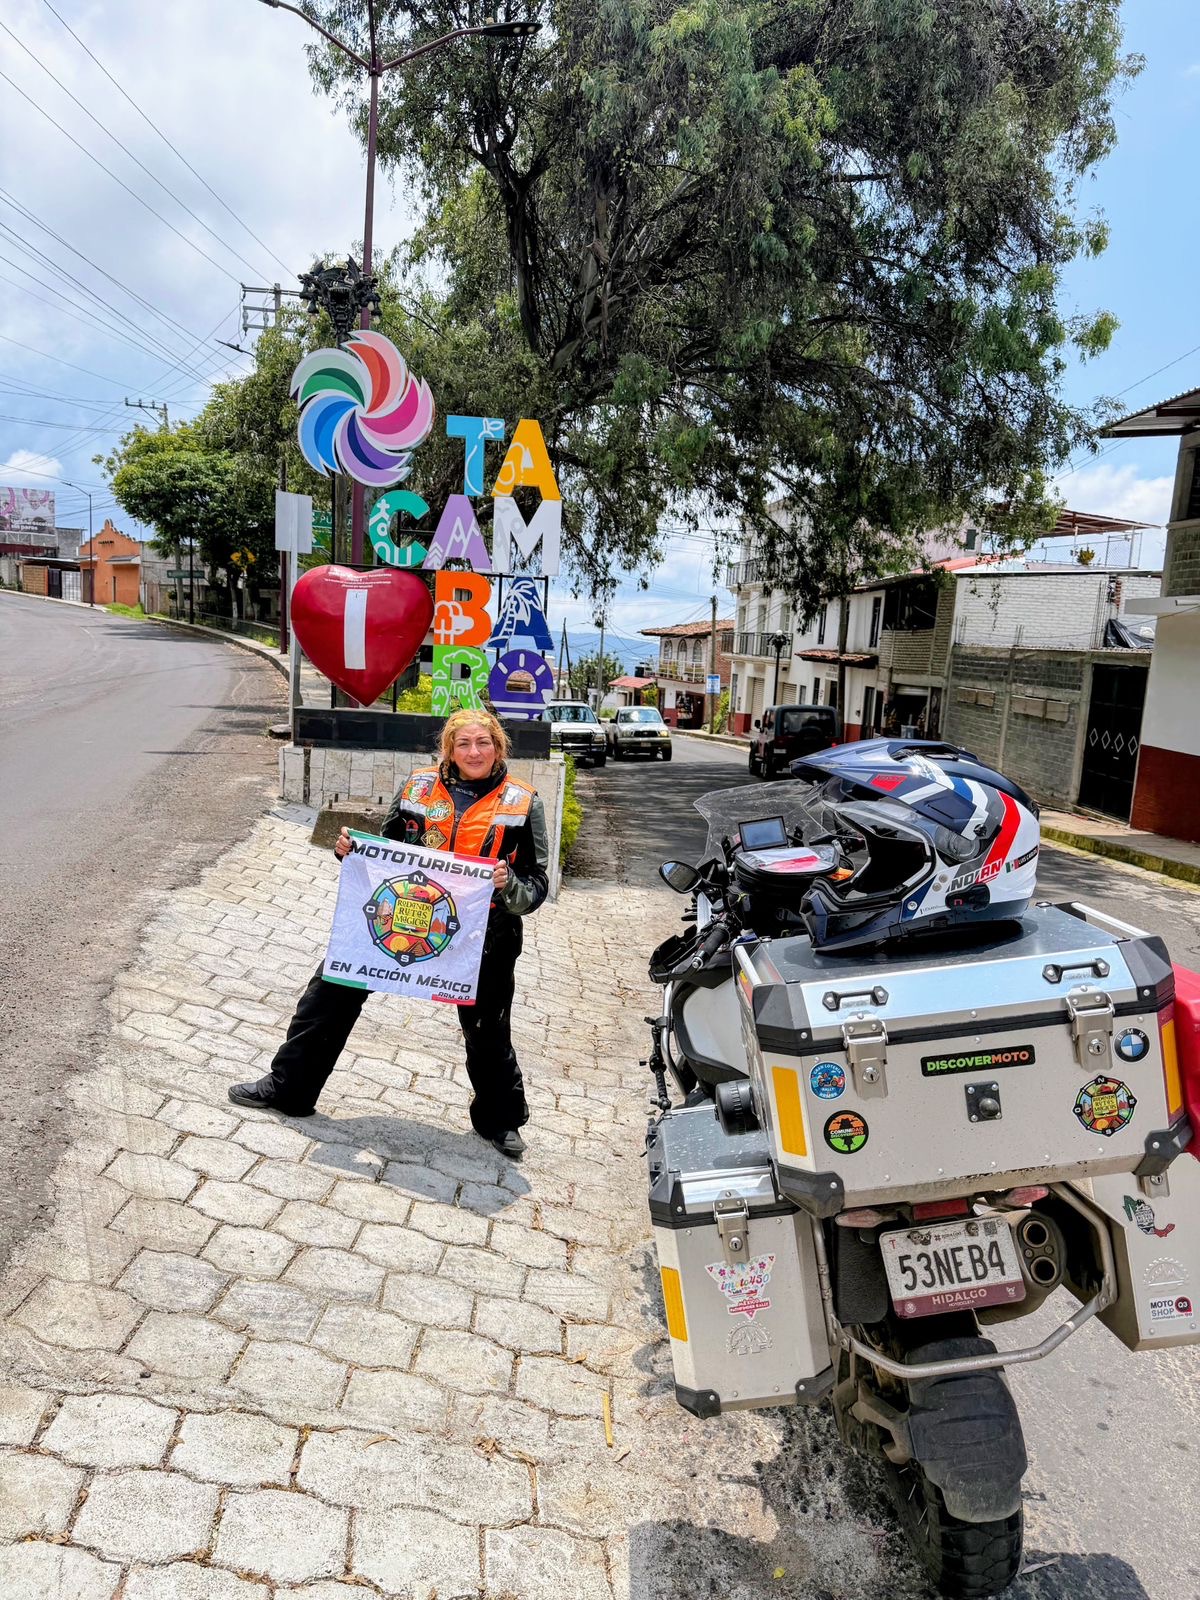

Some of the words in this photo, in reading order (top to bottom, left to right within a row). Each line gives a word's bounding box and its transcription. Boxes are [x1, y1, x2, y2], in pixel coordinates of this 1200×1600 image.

[446, 415, 561, 500] TA
[369, 489, 562, 576] CAM
[434, 570, 554, 650] BA
[432, 645, 554, 721] RO
[352, 840, 493, 880] MOTOTURISMO
[413, 875, 423, 883] N
[449, 922, 457, 930] E
[401, 954, 410, 962] S
[330, 960, 352, 973] EN
[356, 965, 411, 983] ACCIÓN
[416, 974, 472, 994] MÉXICO
[1117, 1028, 1145, 1041] BMW
[926, 1051, 1029, 1072] DISCOVERMOTO
[898, 1240, 1006, 1291] 53NEB4
[932, 1288, 987, 1306] HIDALGO
[1150, 1300, 1174, 1309] MOTO
[1151, 1307, 1174, 1317] SHOP
